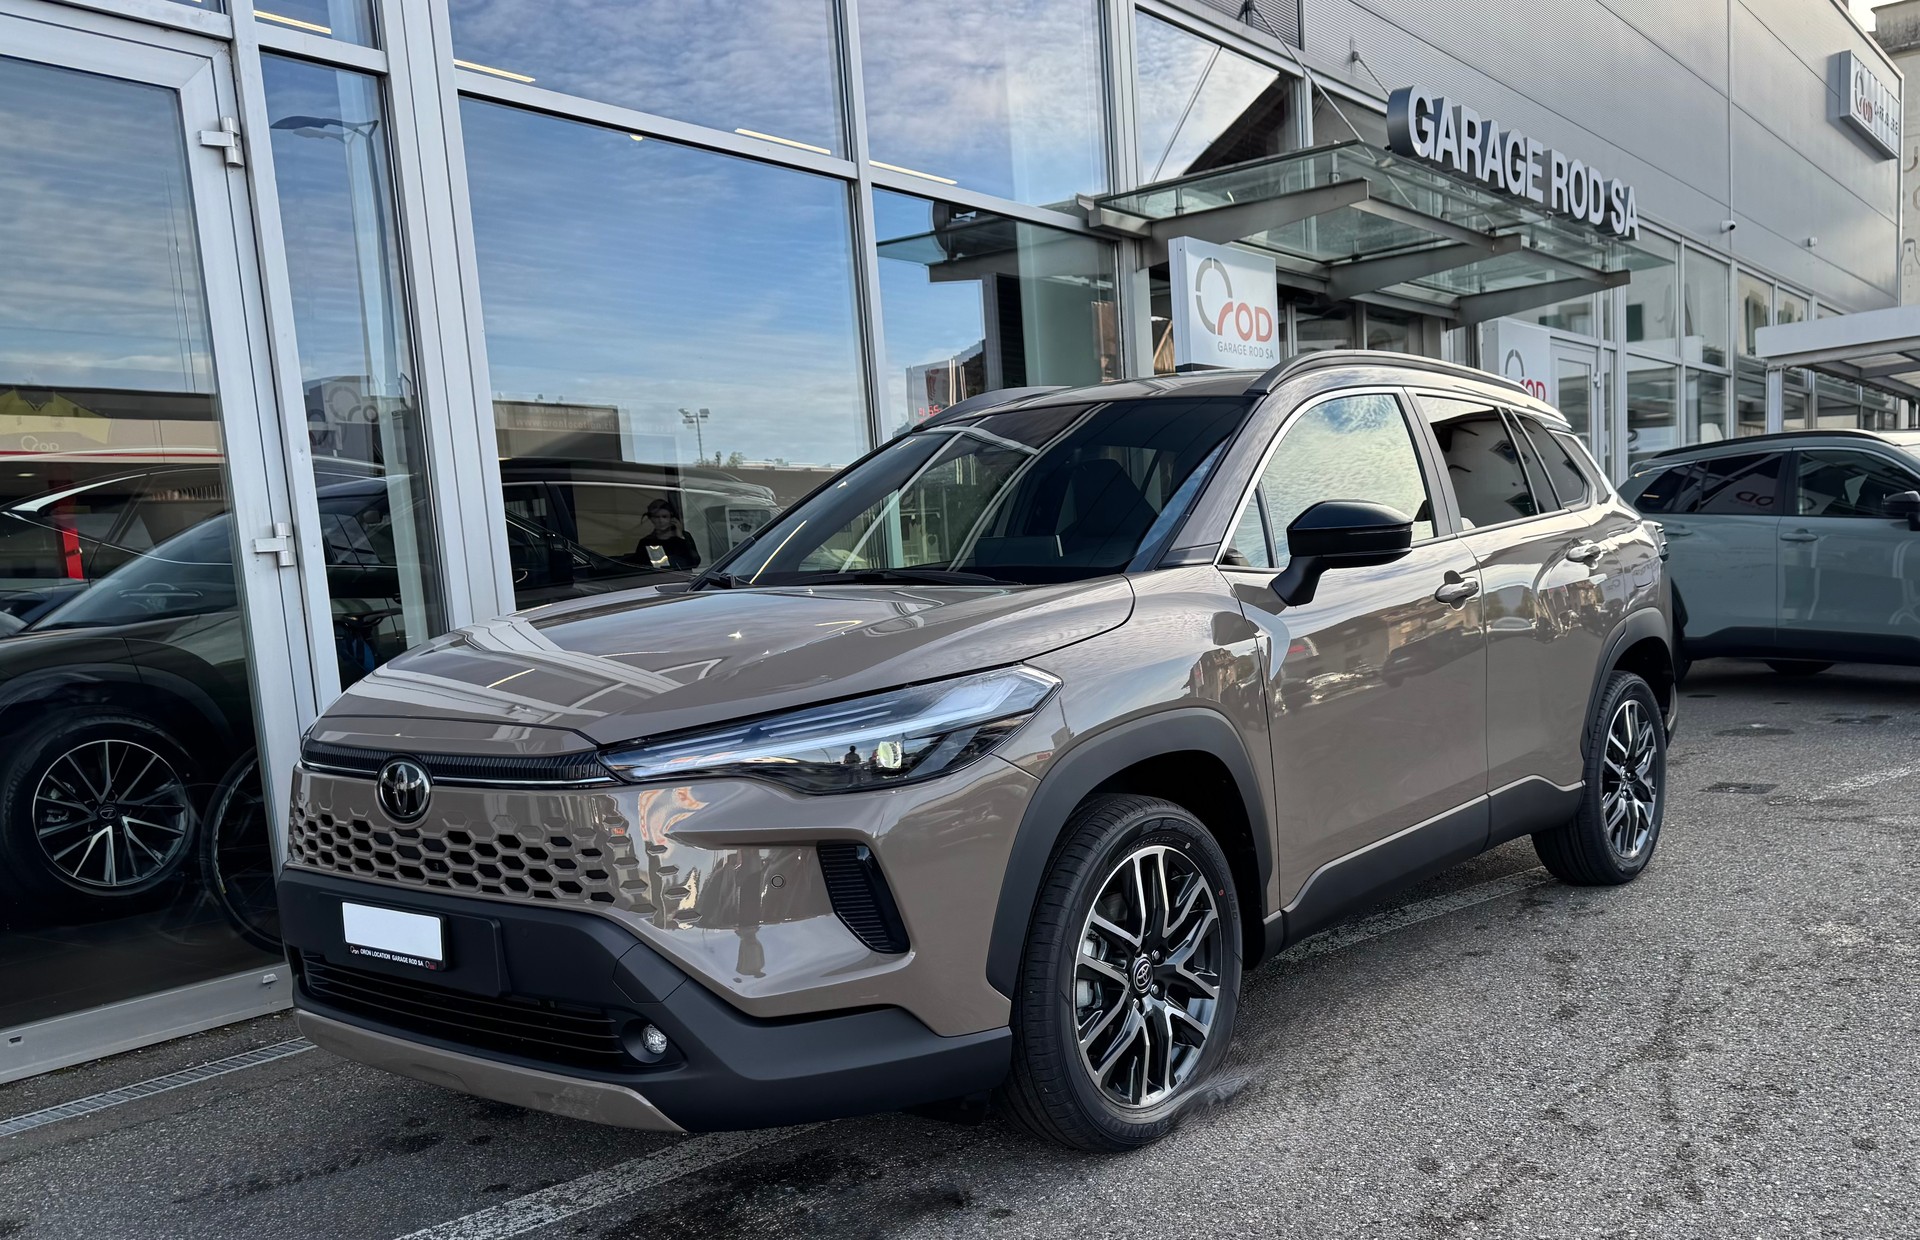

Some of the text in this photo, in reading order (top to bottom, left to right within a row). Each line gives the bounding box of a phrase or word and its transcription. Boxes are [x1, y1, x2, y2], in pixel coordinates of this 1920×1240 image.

[1408, 83, 1640, 240] GARAGE ROD SA
[1217, 341, 1274, 360] GARAGE ROD SA
[372, 951, 391, 960] LOCATION
[392, 954, 409, 964] GARAGE
[409, 957, 418, 966] ROD
